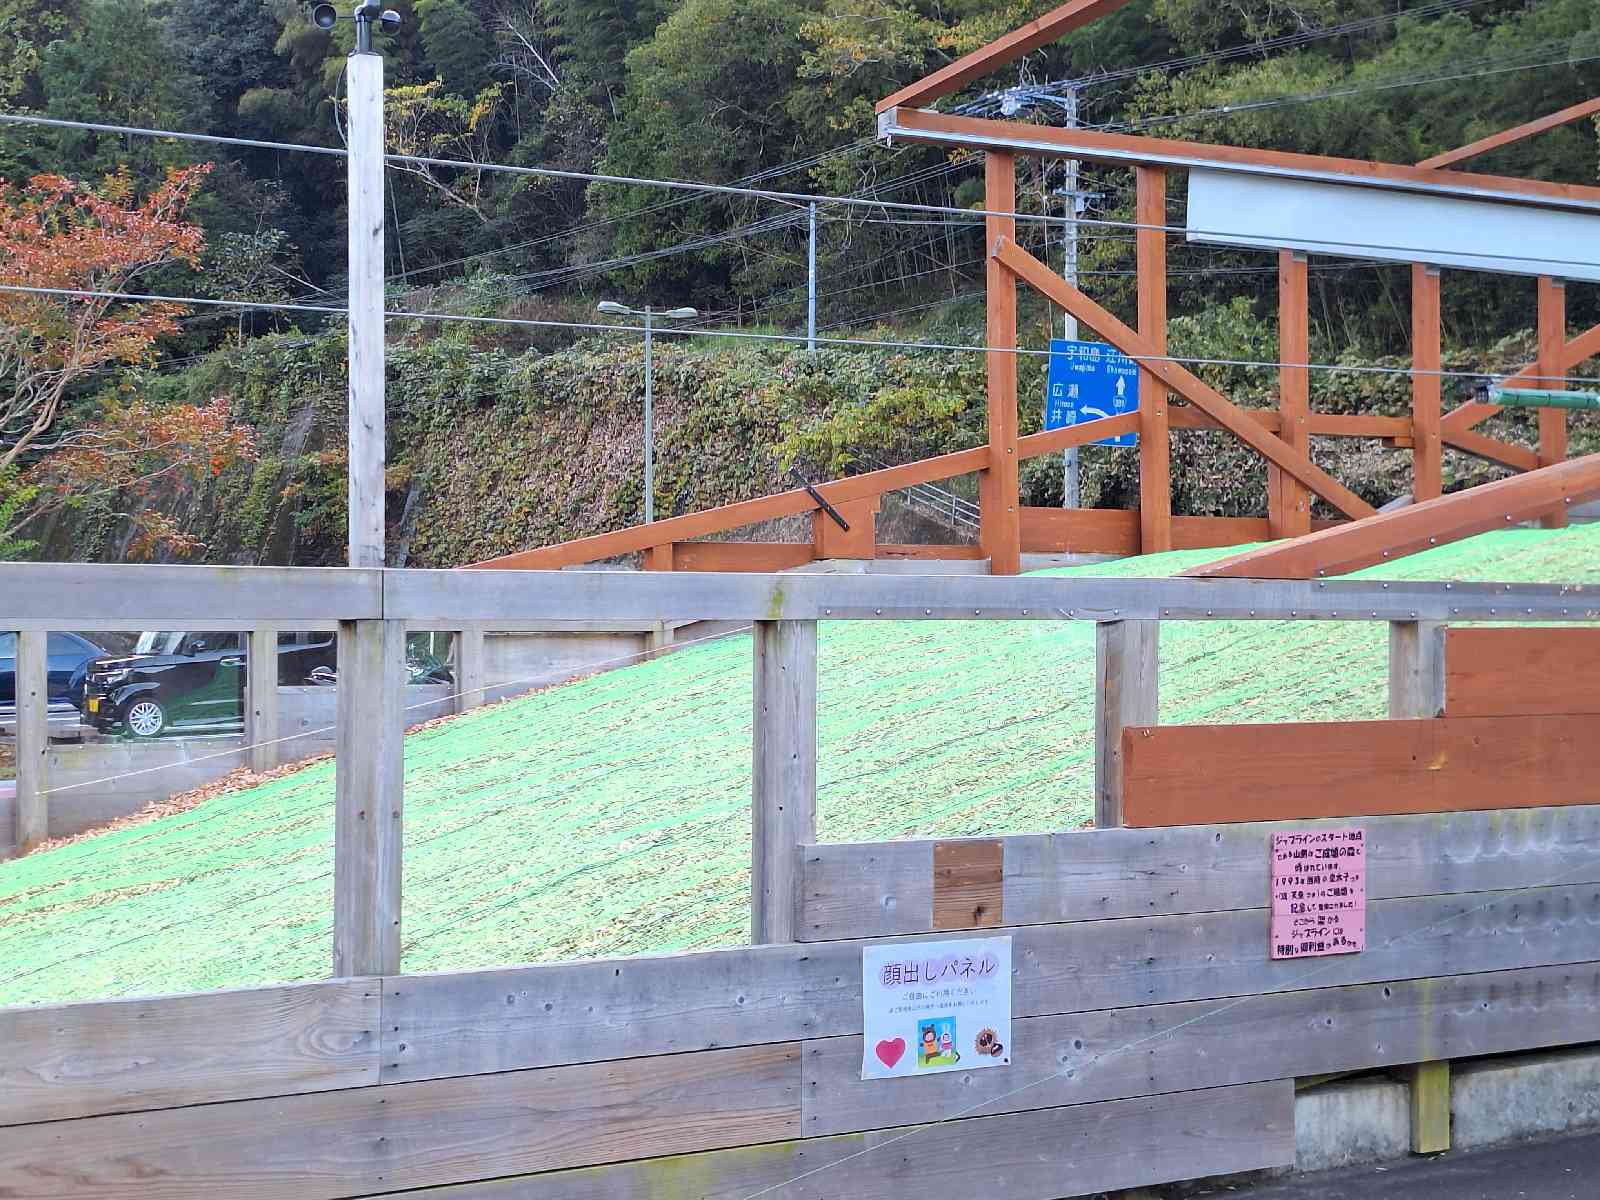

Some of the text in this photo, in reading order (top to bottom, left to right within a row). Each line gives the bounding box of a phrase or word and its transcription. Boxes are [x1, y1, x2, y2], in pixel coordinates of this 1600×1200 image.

[1066, 345, 1101, 363] 宇和島
[883, 957, 996, 985] 顔出しパネル
